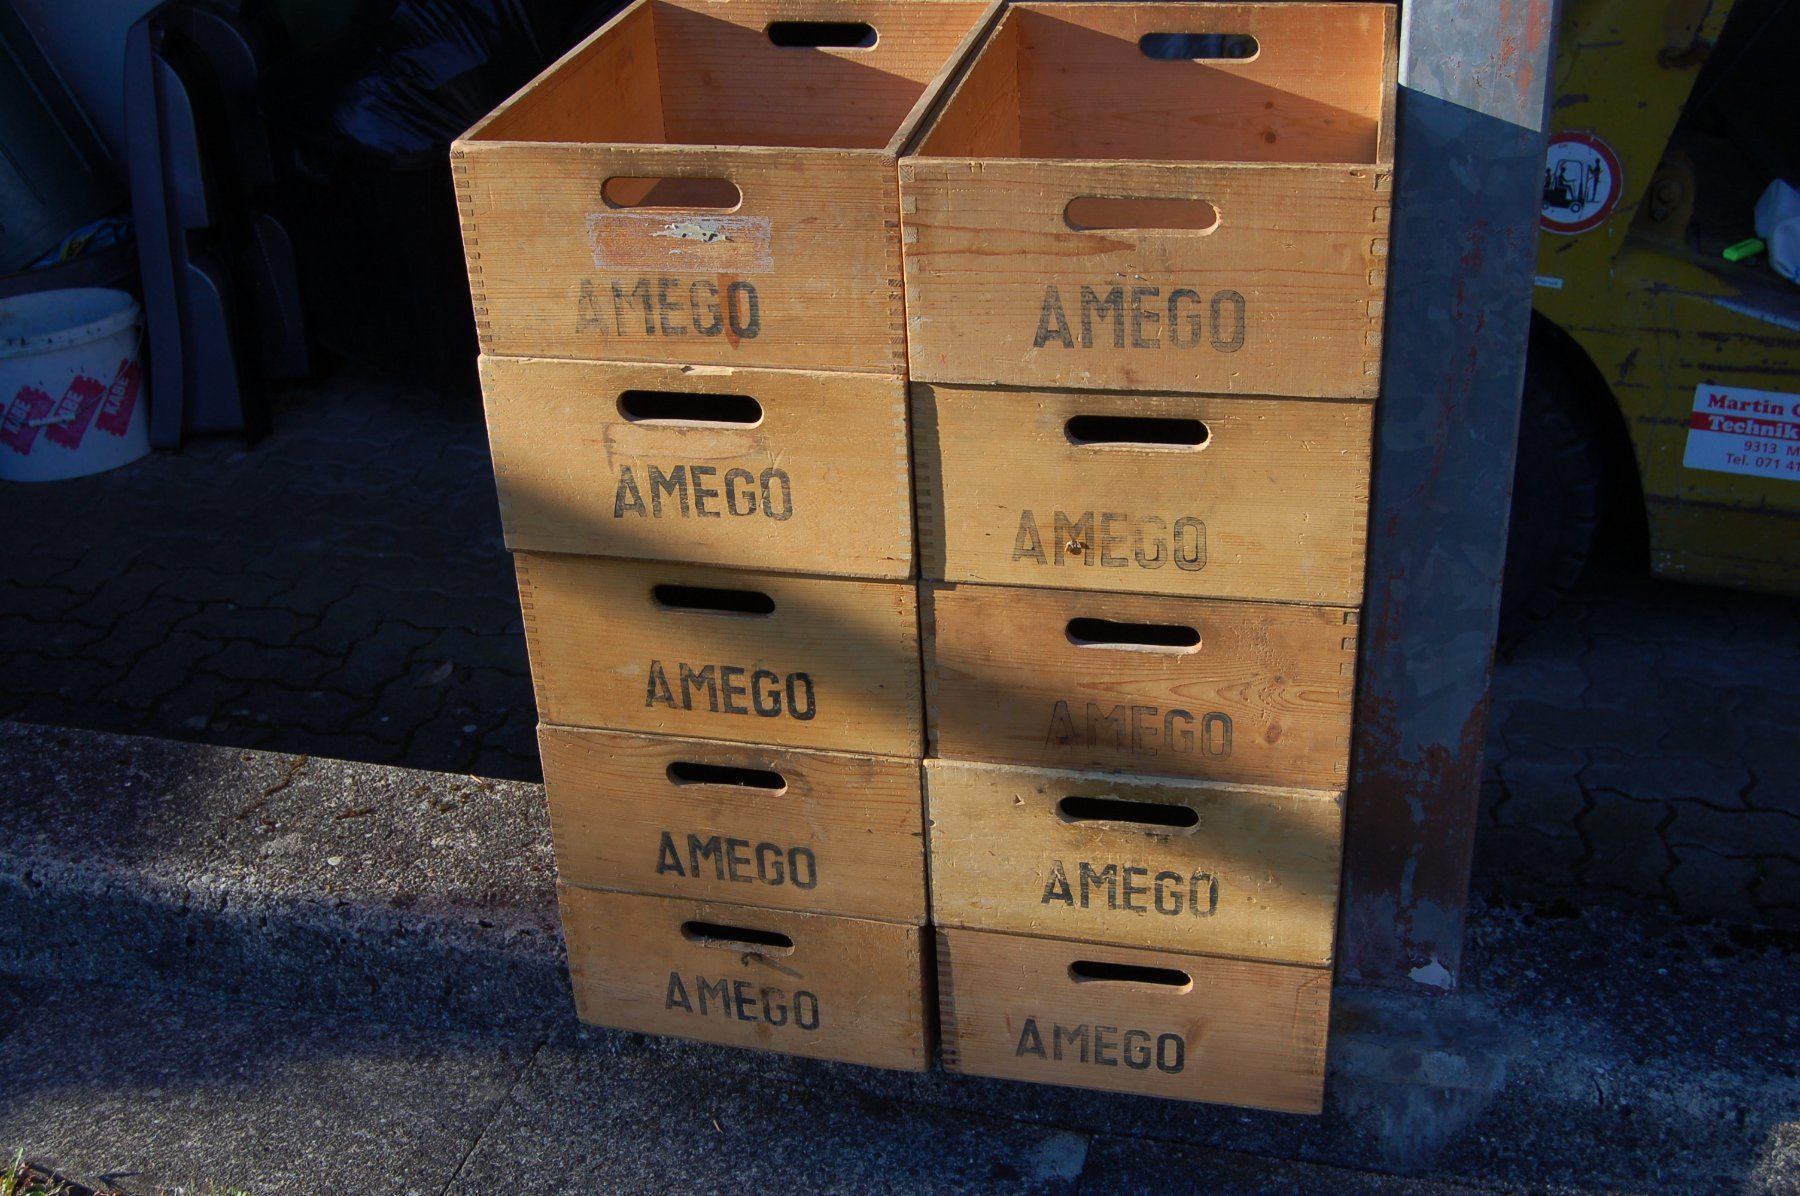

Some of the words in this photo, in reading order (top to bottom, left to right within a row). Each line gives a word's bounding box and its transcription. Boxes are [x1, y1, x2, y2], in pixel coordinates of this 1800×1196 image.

[576, 277, 760, 339] AMEGO
[1033, 286, 1245, 353] AMEGO
[3, 397, 32, 434] KABE
[103, 375, 129, 415] KABE
[1707, 393, 1785, 416] Martin
[1708, 414, 1800, 441] Technik
[1744, 440, 1778, 454] 9313
[1726, 452, 1750, 466] Tel.
[1755, 457, 1780, 469] 071
[614, 464, 793, 521] AMEGO
[1011, 509, 1207, 572] AMEGO
[645, 659, 816, 721] AMEGO
[1044, 700, 1233, 762] AMEGO
[656, 831, 818, 890] AMEGO
[1041, 859, 1220, 918] AMEGO
[665, 971, 820, 1030] AMEGO
[1016, 1015, 1185, 1074] AMEGO
